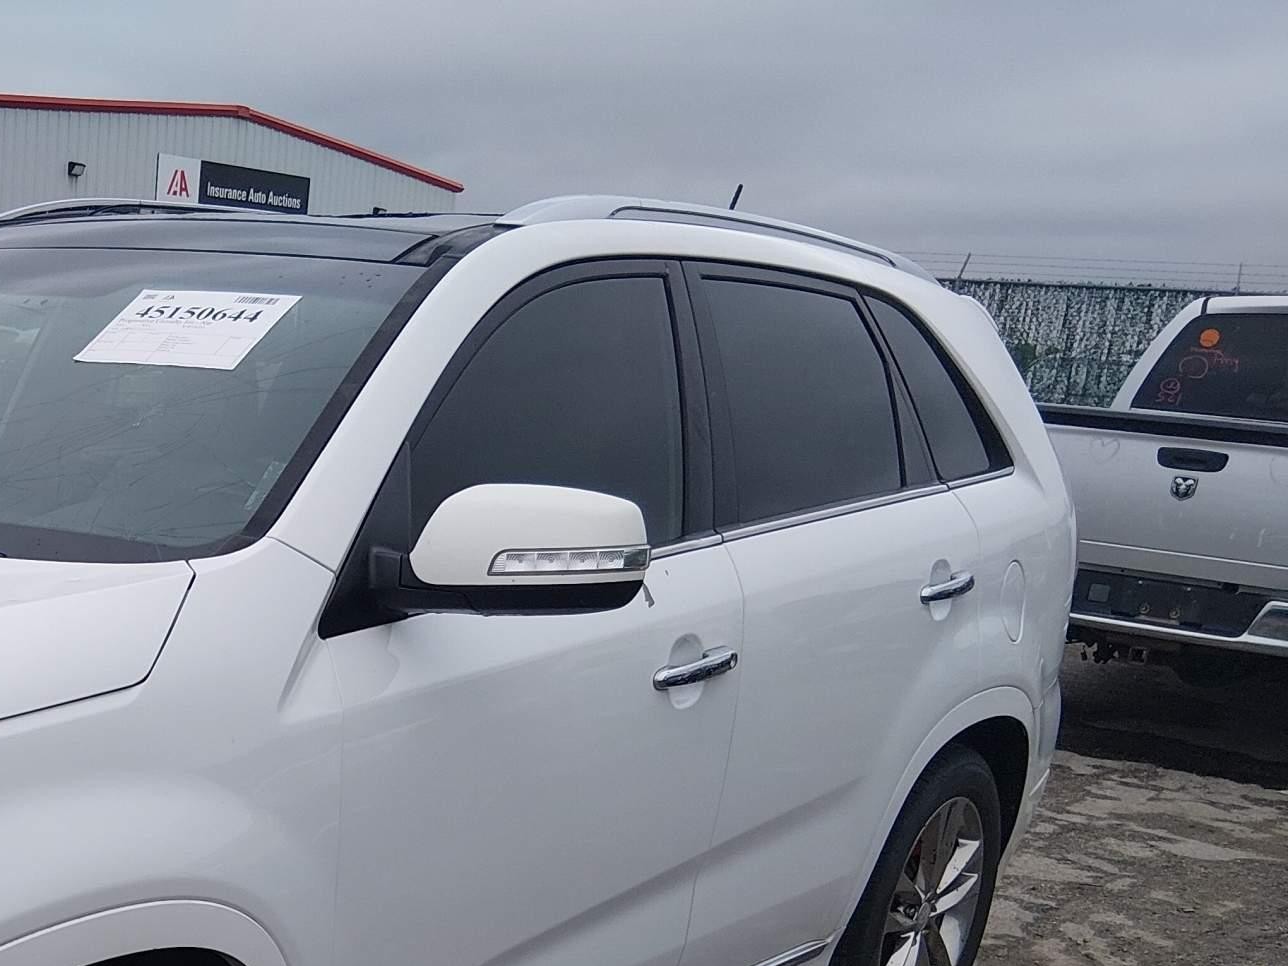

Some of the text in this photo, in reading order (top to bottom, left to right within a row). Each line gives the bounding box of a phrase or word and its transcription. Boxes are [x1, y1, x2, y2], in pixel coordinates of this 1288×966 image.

[207, 182, 301, 209] Insurance Auto Auctions
[136, 305, 264, 322] 45150644
